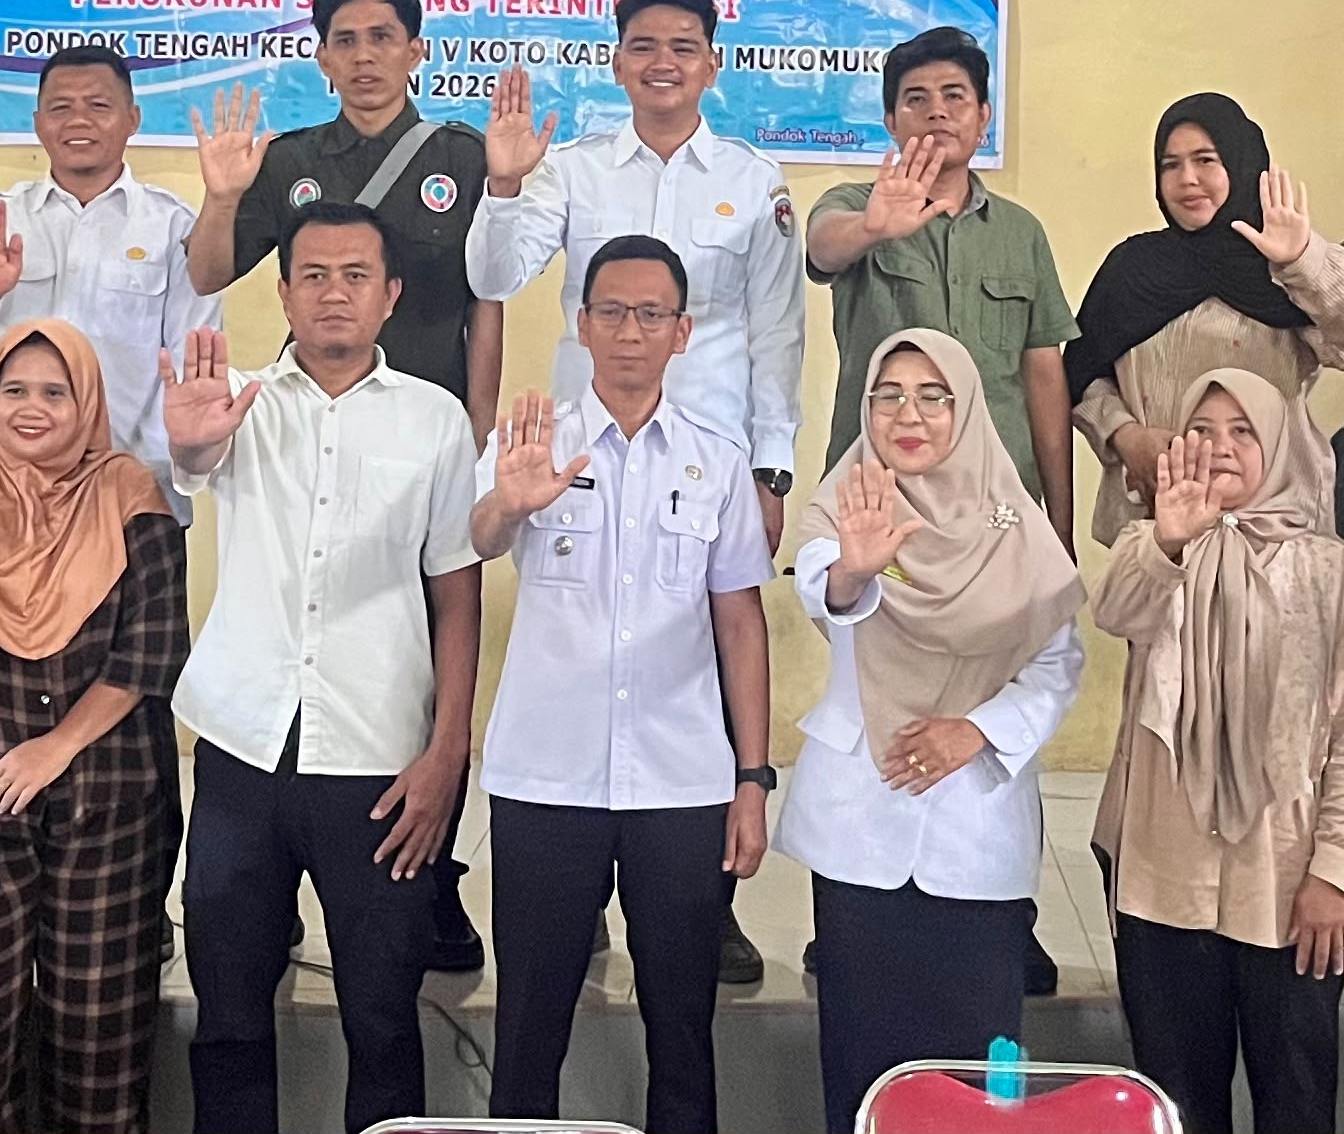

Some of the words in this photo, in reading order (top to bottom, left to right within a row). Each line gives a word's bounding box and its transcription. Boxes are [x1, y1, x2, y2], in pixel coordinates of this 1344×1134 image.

[7, 31, 126, 55] PONDOK
[136, 33, 249, 58] TENGAH
[442, 39, 460, 62] V
[469, 40, 546, 64] KOTO
[431, 75, 496, 97] 2026
[756, 129, 807, 142] Pondok
